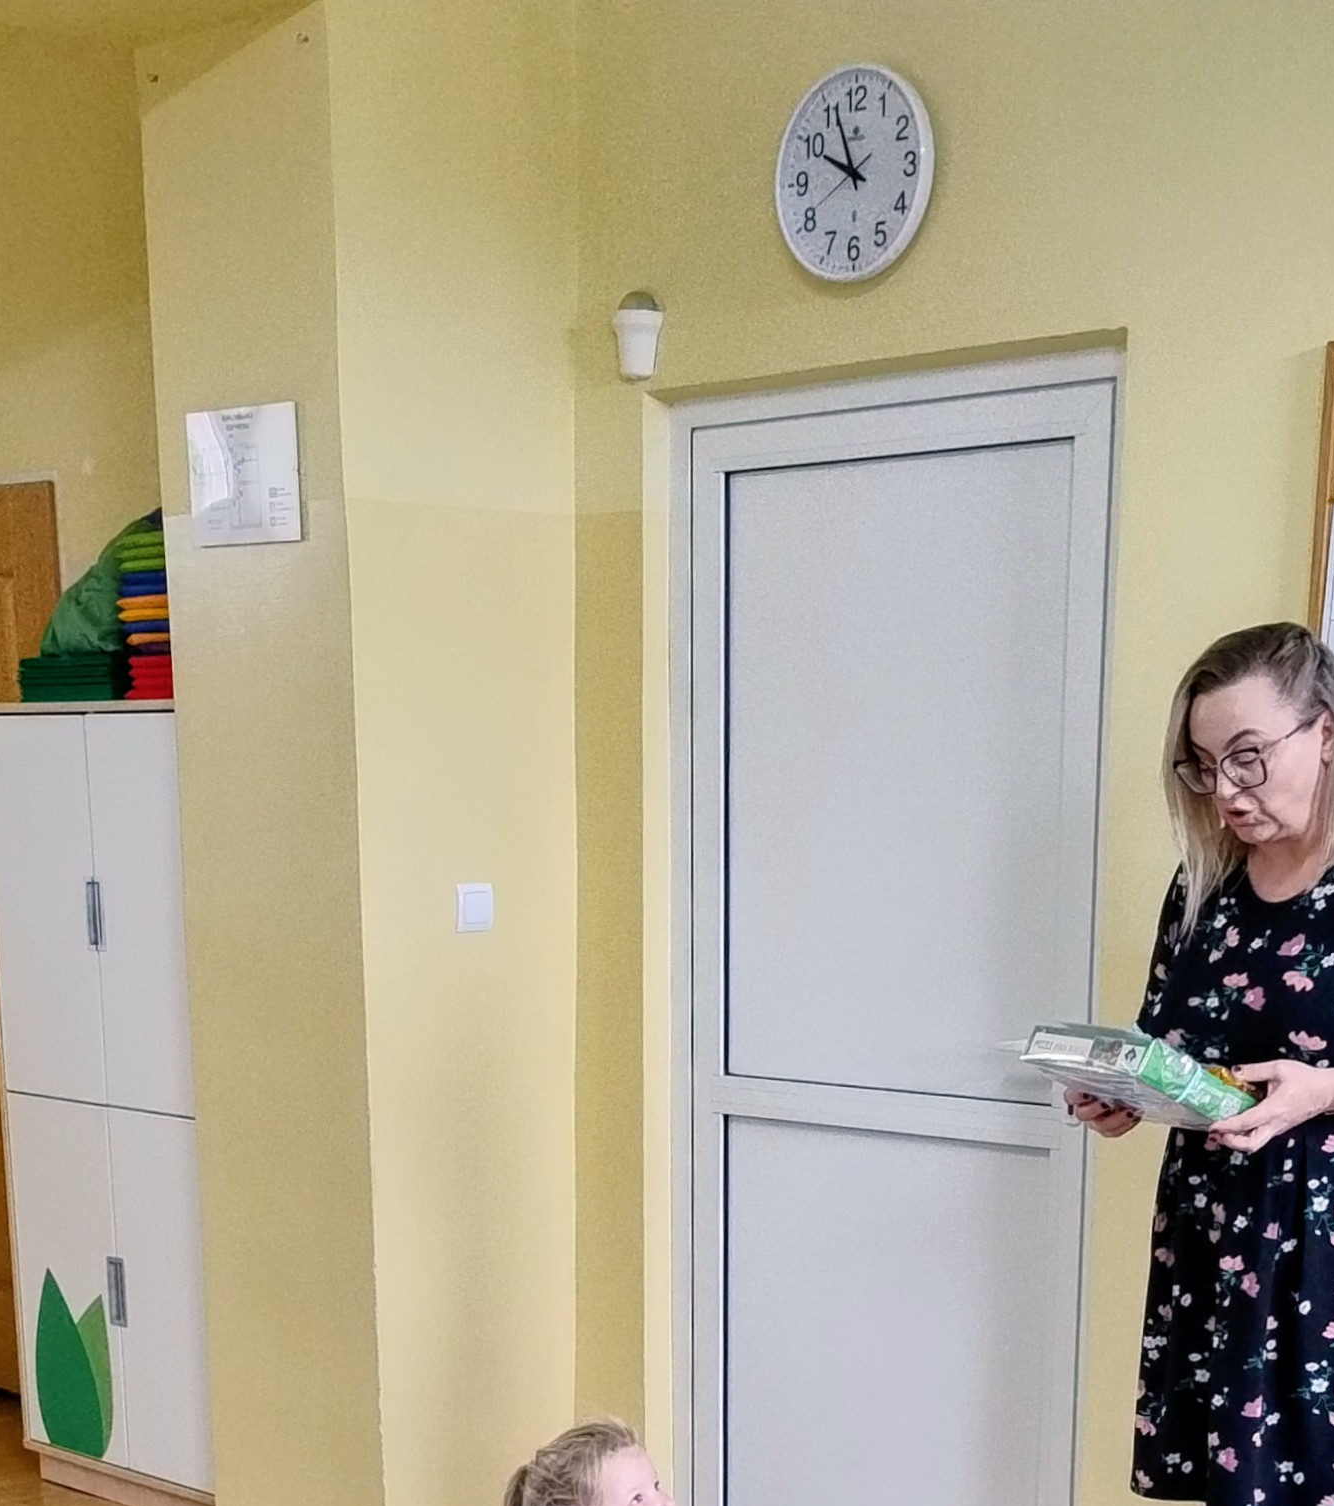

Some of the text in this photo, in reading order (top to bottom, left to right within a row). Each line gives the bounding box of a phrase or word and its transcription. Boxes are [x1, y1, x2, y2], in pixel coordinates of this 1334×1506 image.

[846, 85, 867, 112] 12
[879, 92, 886, 117] 1
[824, 102, 840, 128] 11
[895, 115, 909, 141] 2
[804, 132, 824, 159] 10
[903, 151, 917, 177] 3
[796, 171, 808, 196] 9
[894, 190, 907, 215] 4
[803, 207, 816, 232] 8
[824, 231, 837, 256] 7
[873, 221, 887, 247] 5
[847, 236, 860, 261] 6
